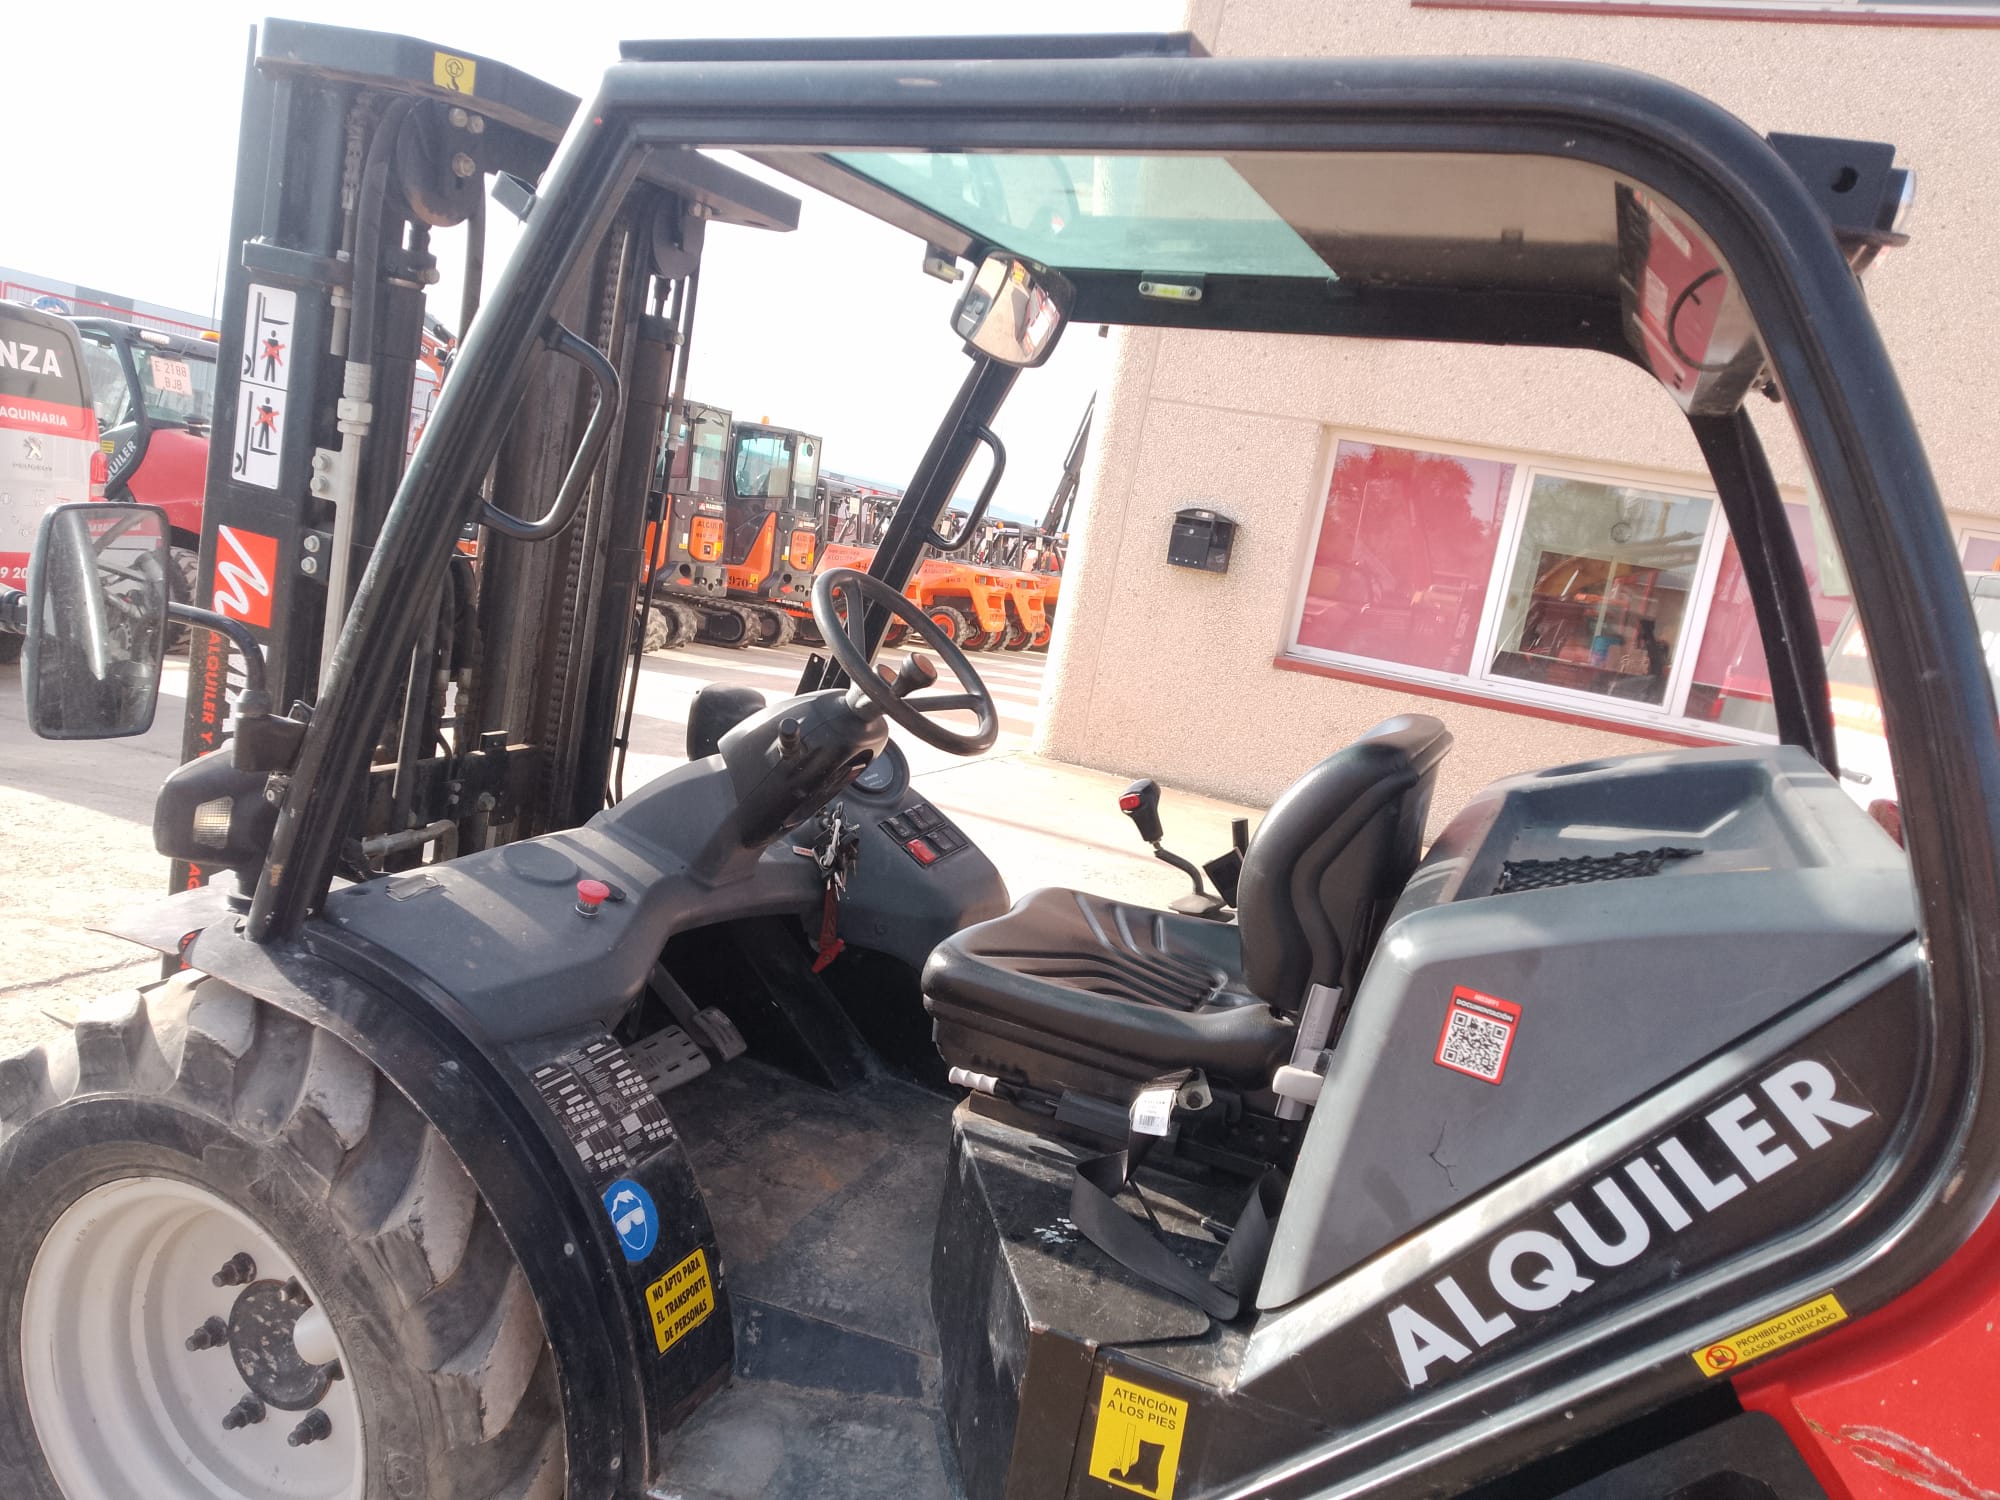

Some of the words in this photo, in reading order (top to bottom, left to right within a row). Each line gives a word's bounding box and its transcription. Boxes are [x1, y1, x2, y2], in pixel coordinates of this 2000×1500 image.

[201, 731, 214, 745] Y
[1387, 1060, 1874, 1389] ALQUILER
[652, 1285, 663, 1303] NO
[665, 1272, 682, 1295] APTO
[683, 1256, 701, 1279] PARA
[656, 1309, 666, 1325] EL
[665, 1275, 707, 1317] TRANSPORTE
[664, 1328, 675, 1344] DE
[674, 1299, 707, 1336] PERSONAS
[1735, 1322, 1787, 1349] PROHIBIDO
[1788, 1304, 1829, 1327] UTILIZAR
[1742, 1338, 1779, 1358] GASOIL
[1779, 1312, 1837, 1342] BONIFICADO
[1107, 1399, 1116, 1411] A
[1119, 1403, 1144, 1420] LOS
[1147, 1412, 1177, 1431] PIES
[1113, 1387, 1178, 1417] ATENCIÓN
